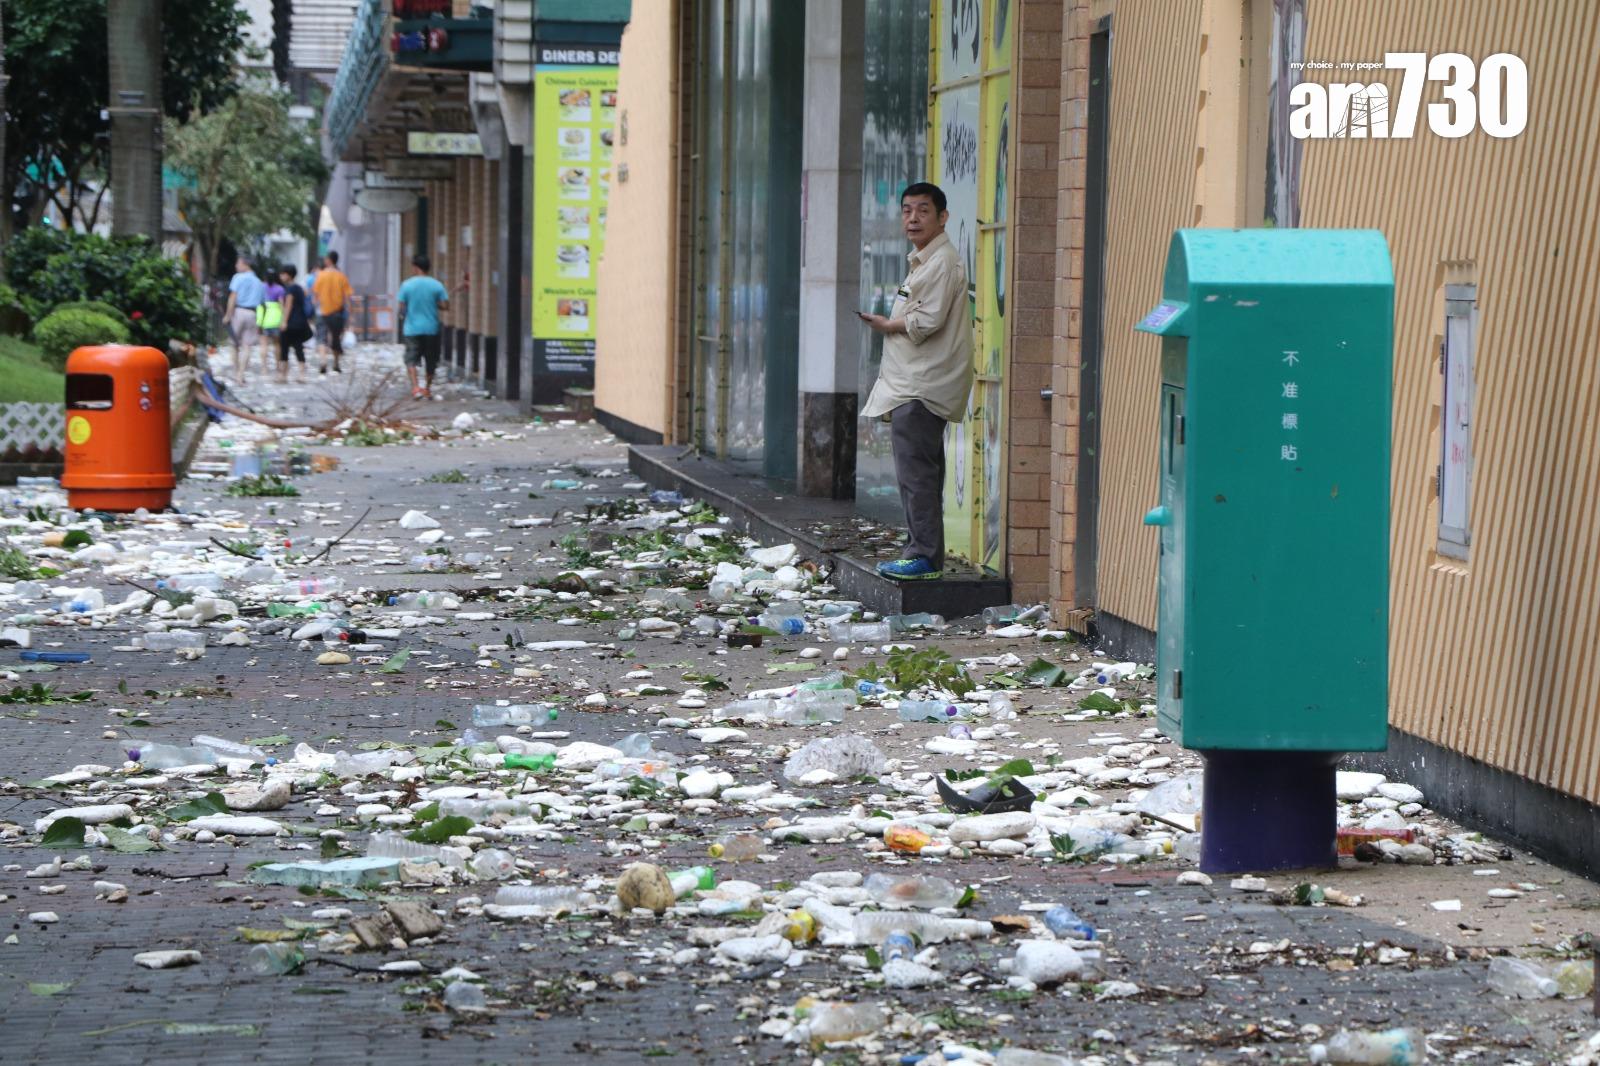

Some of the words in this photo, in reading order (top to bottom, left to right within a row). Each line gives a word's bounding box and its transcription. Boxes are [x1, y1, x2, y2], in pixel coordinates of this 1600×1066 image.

[542, 50, 595, 63] DINERS
[545, 76, 577, 85] Chinese
[579, 77, 608, 86] Cuisine
[1281, 350, 1300, 461] 不准標貼
